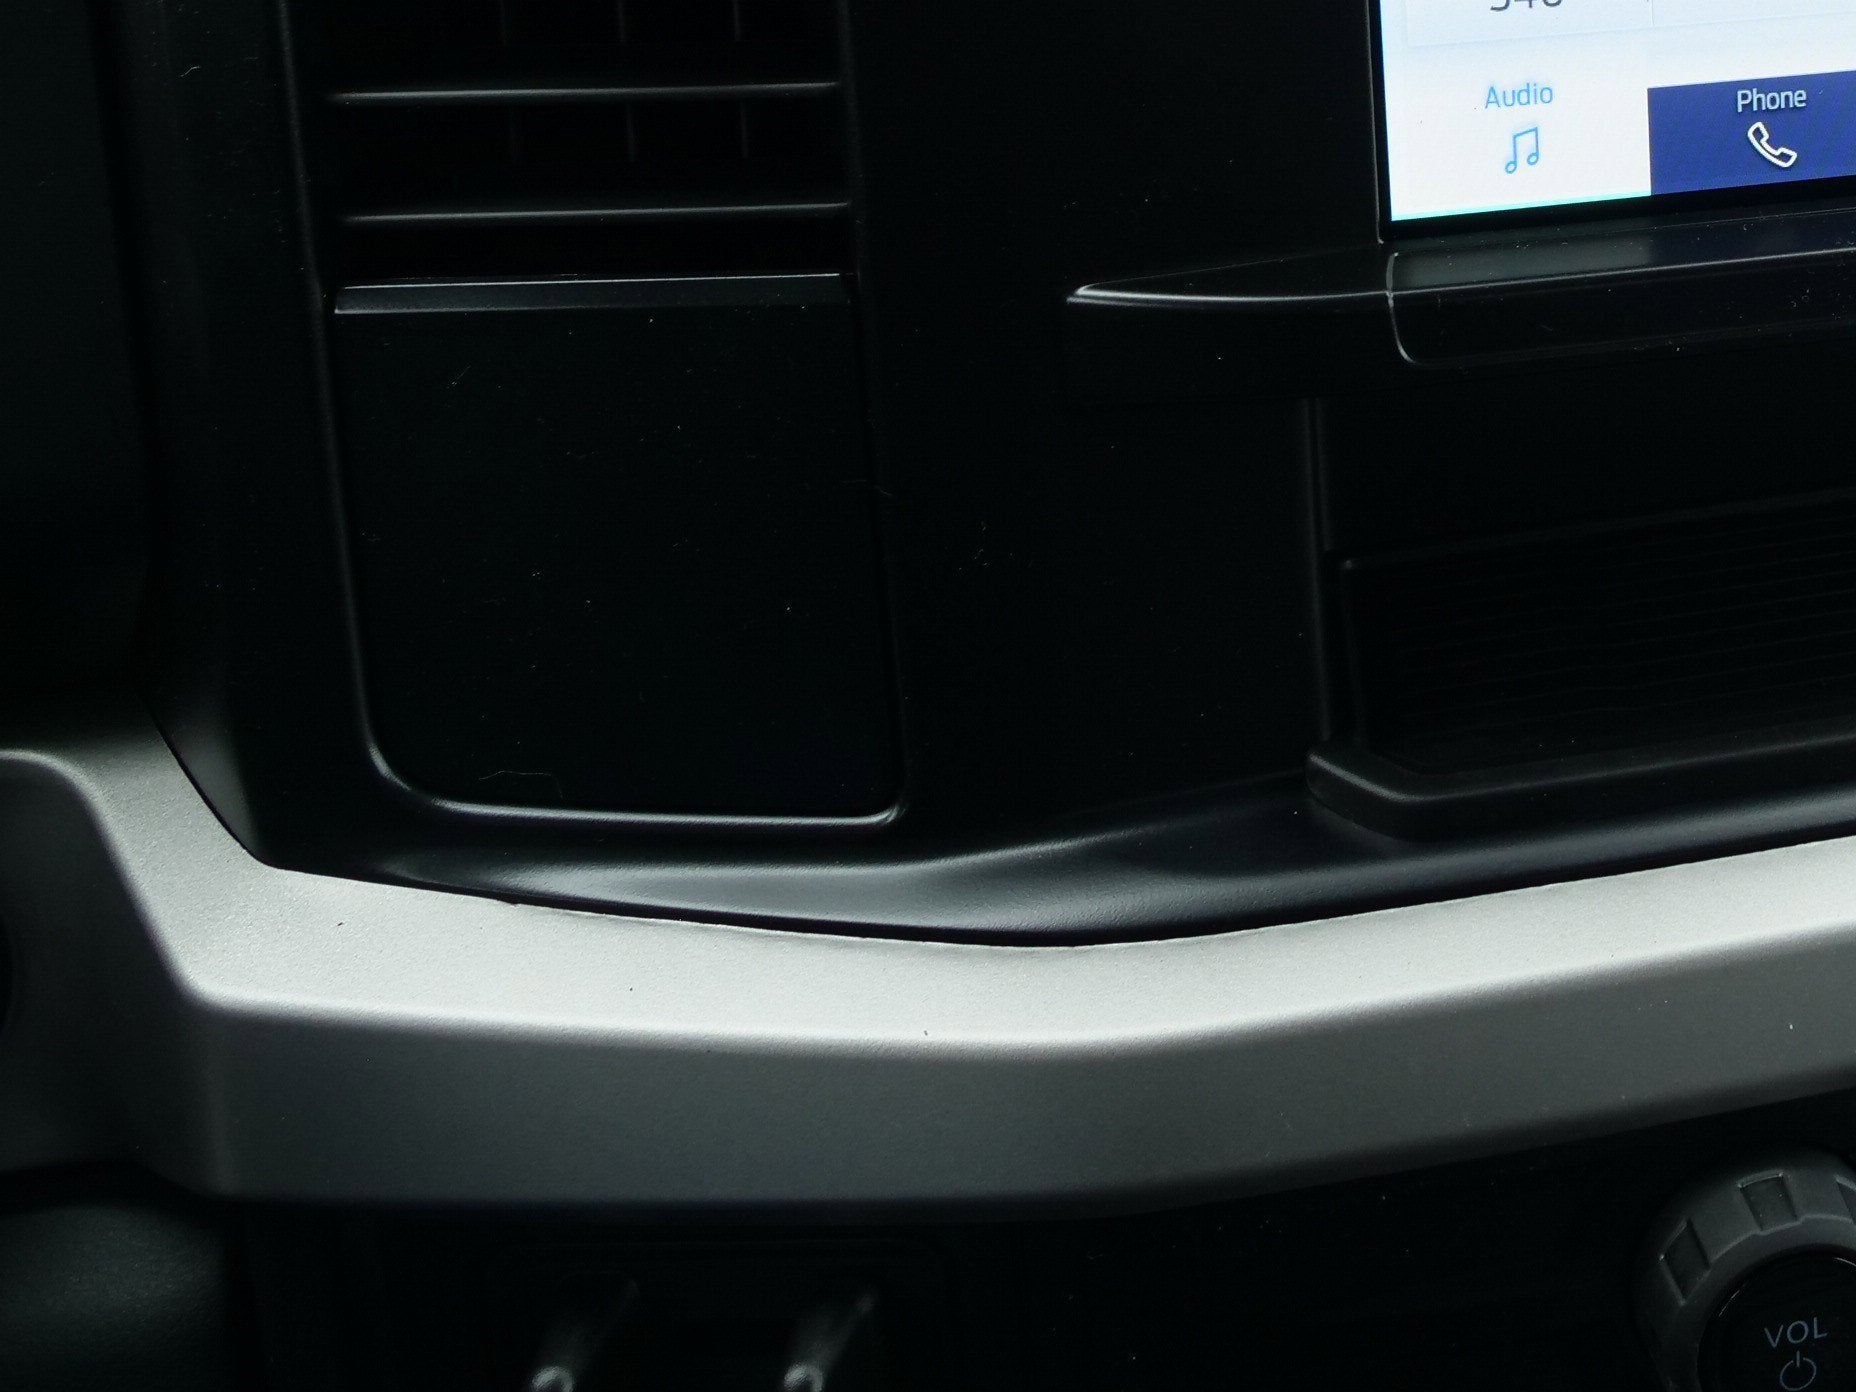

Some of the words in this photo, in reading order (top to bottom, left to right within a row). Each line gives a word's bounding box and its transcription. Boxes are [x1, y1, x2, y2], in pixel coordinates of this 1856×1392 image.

[1485, 83, 1554, 110] Audio
[1735, 86, 1808, 113] Phone
[1764, 1316, 1829, 1348] VOL
